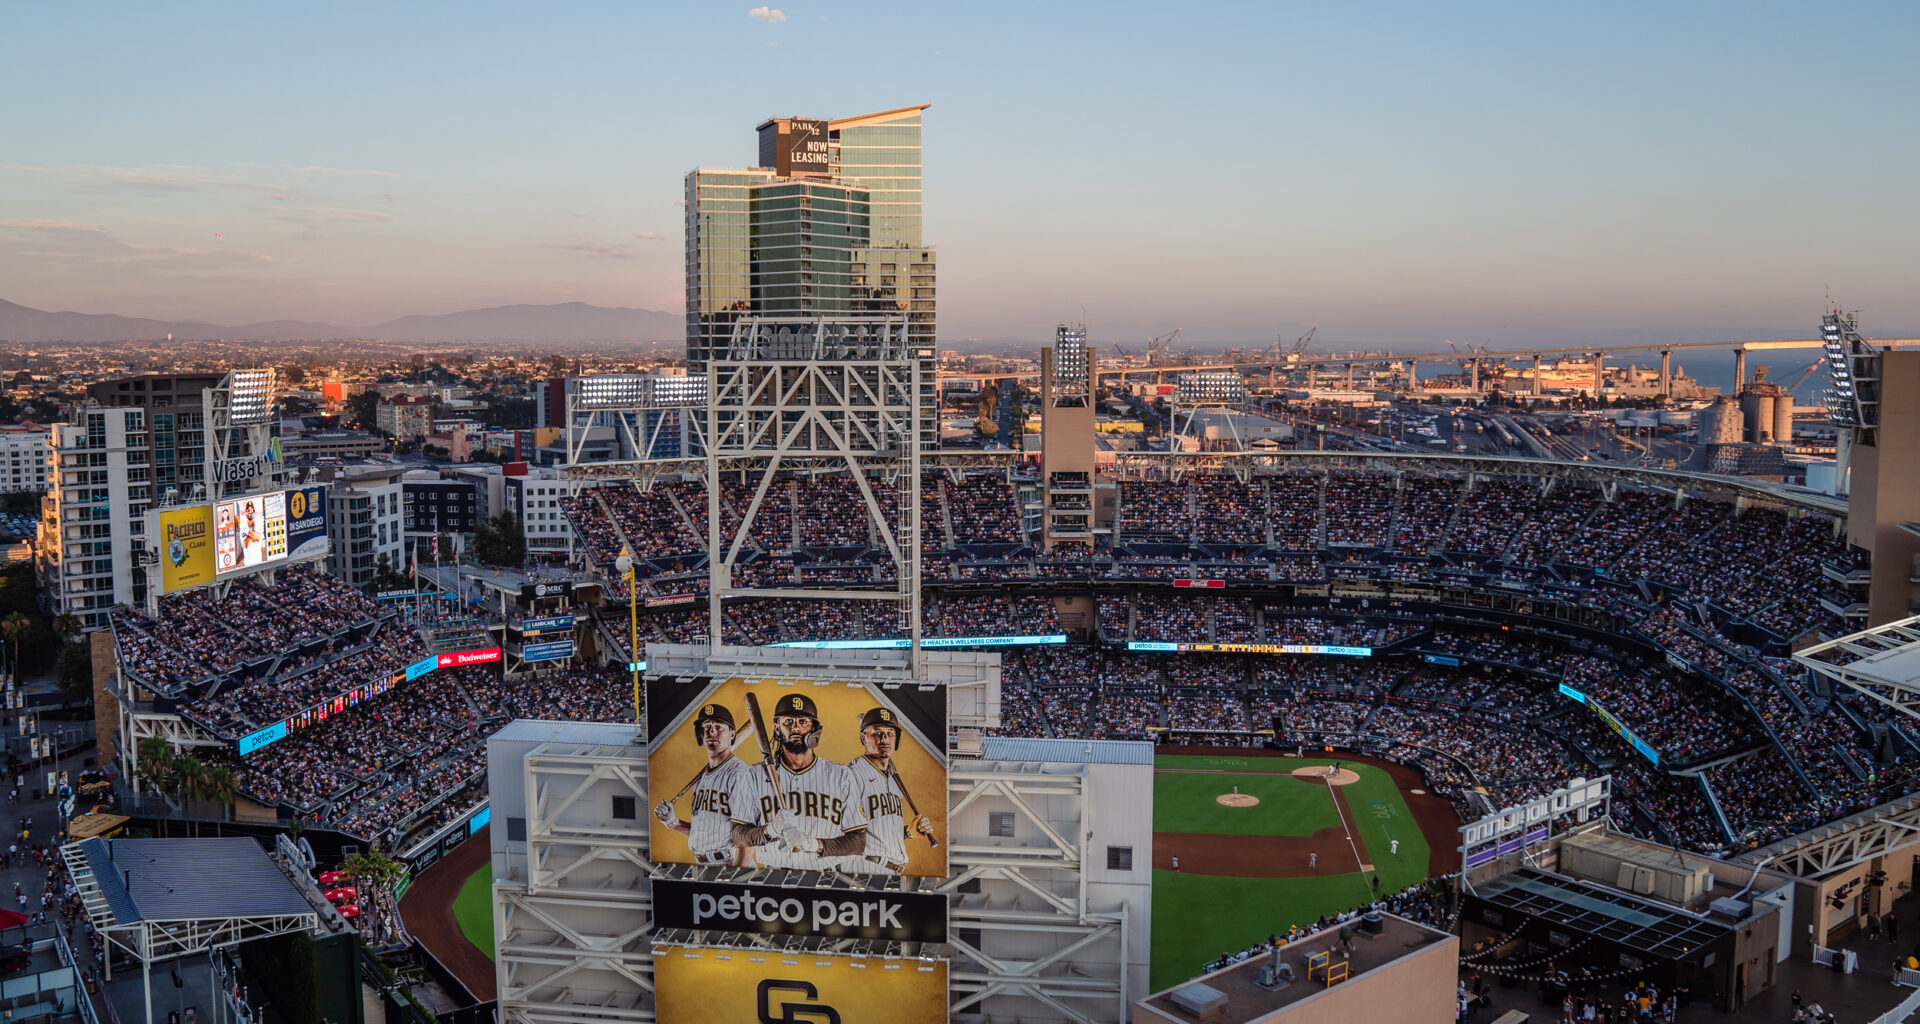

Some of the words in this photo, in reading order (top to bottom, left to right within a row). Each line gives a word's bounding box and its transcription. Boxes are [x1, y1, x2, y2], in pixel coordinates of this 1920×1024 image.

[791, 122, 814, 131] PARK
[811, 127, 820, 135] 12
[807, 141, 828, 152] NOW
[791, 152, 828, 164] LEASING
[213, 455, 263, 482] Viasat
[292, 496, 304, 514] #1
[295, 519, 306, 530] SAN
[306, 516, 324, 527] DIEGO
[545, 584, 564, 592] MRC
[458, 651, 498, 663] Budweiser
[414, 661, 430, 676] petco
[792, 697, 803, 710] SD
[704, 704, 714, 716] SD
[880, 709, 890, 721] SD
[251, 729, 275, 748] petco
[692, 889, 804, 925] petco
[812, 899, 903, 932] park
